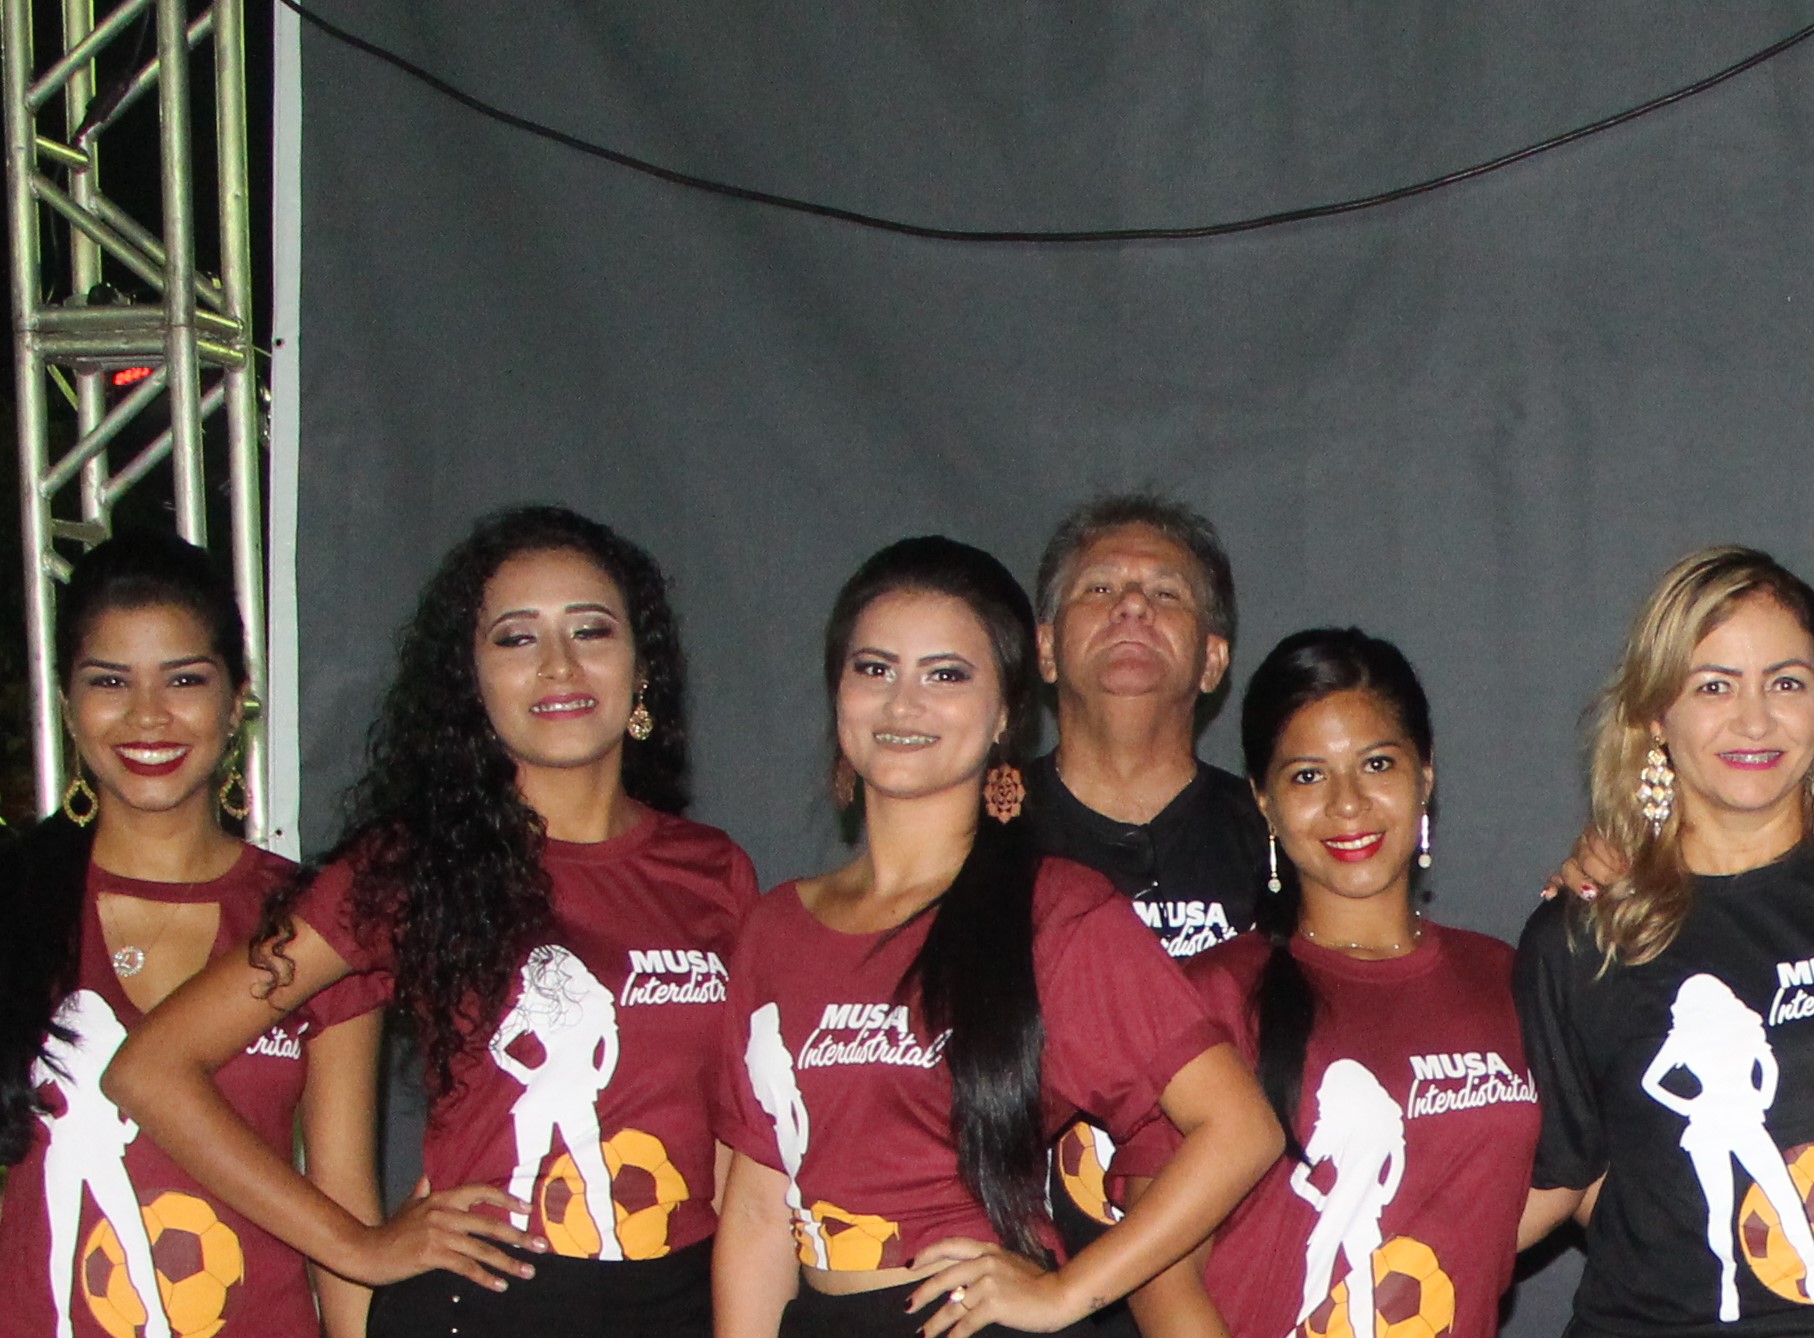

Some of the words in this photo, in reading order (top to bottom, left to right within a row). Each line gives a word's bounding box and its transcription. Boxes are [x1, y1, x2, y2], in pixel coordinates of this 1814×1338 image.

[1132, 900, 1229, 928] MUSA
[628, 949, 729, 977] MUSA
[620, 966, 729, 1006] Interdistr
[819, 1003, 910, 1033] MUSA
[1409, 1052, 1513, 1081] MUSA
[1407, 1066, 1539, 1120] Interdistrital
